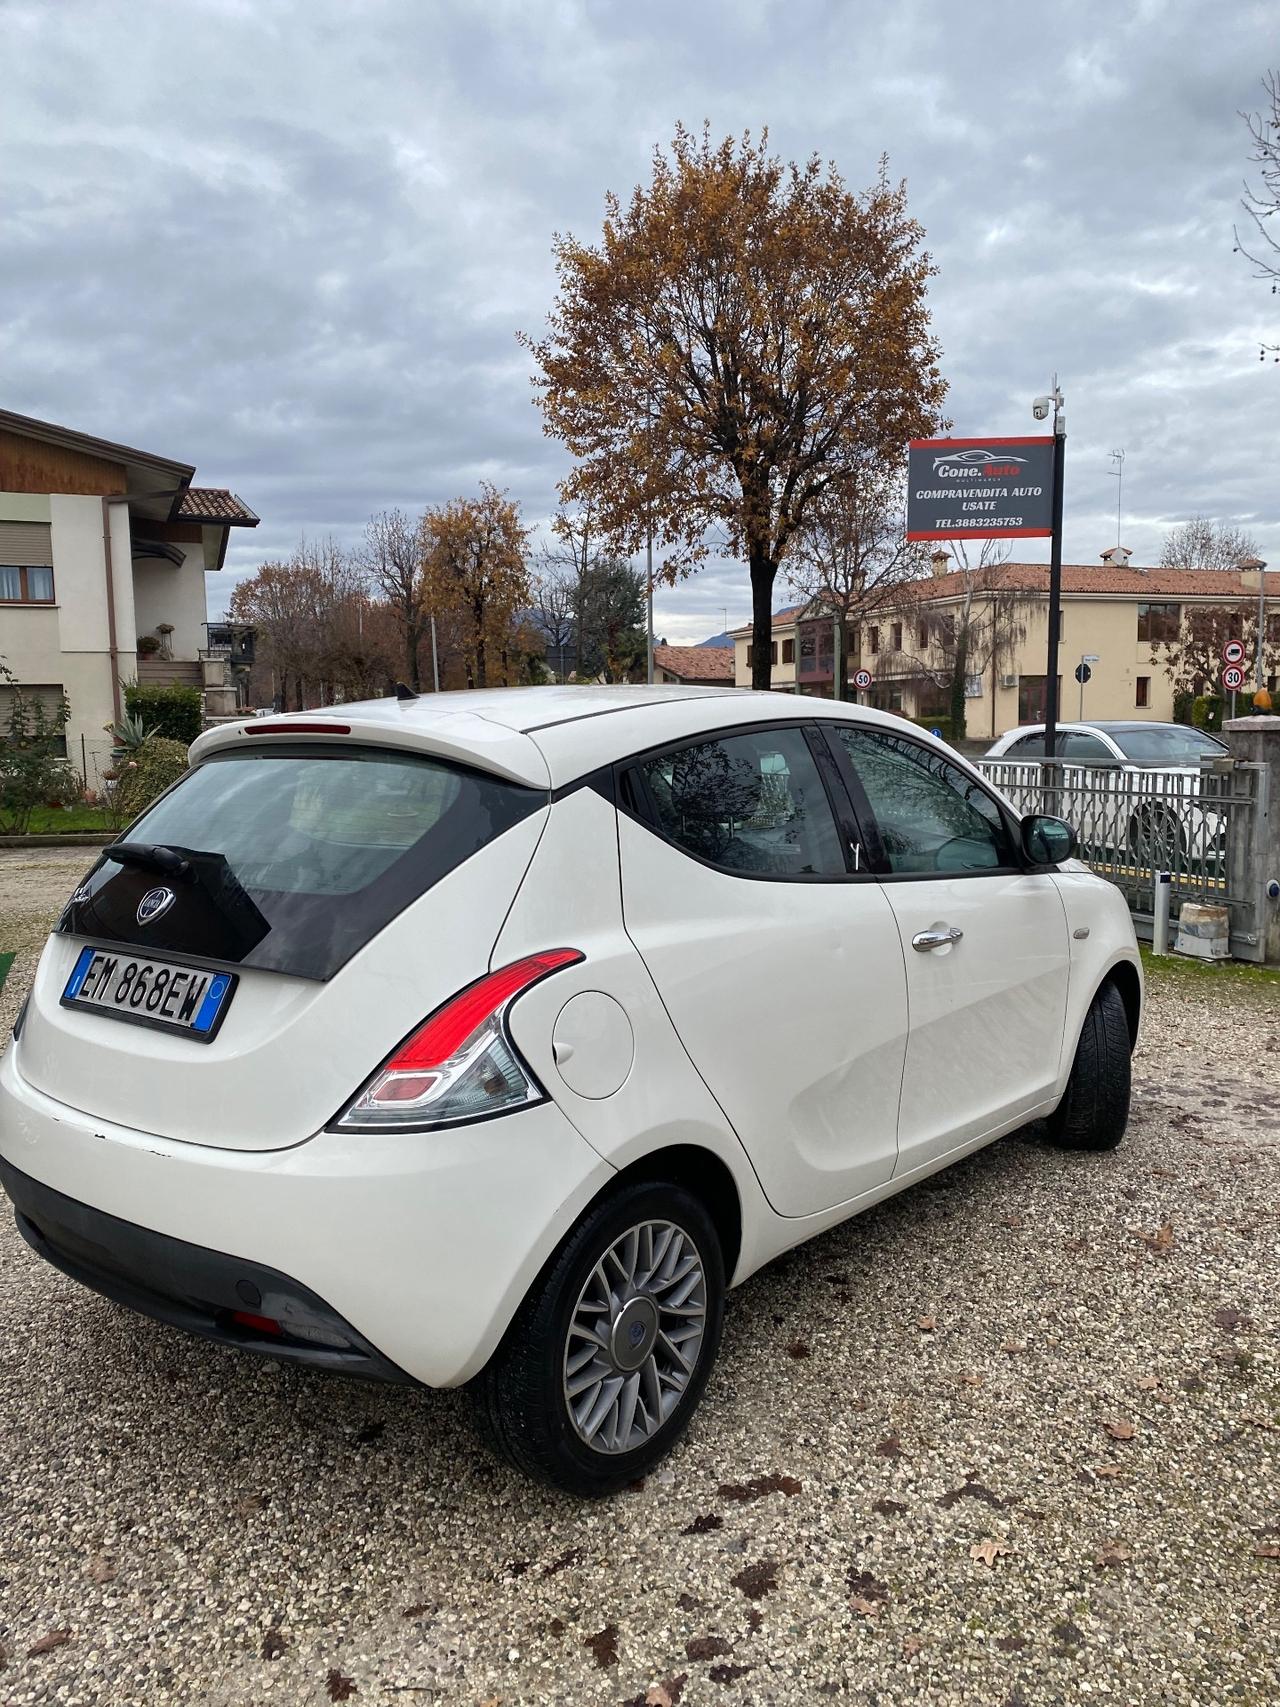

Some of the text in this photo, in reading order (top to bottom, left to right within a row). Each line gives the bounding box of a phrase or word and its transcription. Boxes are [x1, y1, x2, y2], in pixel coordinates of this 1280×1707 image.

[916, 486, 1042, 499] COMPRAVENDITA AUTO
[962, 501, 997, 511] USATE
[858, 674, 868, 684] 50
[1227, 672, 1239, 683] 30
